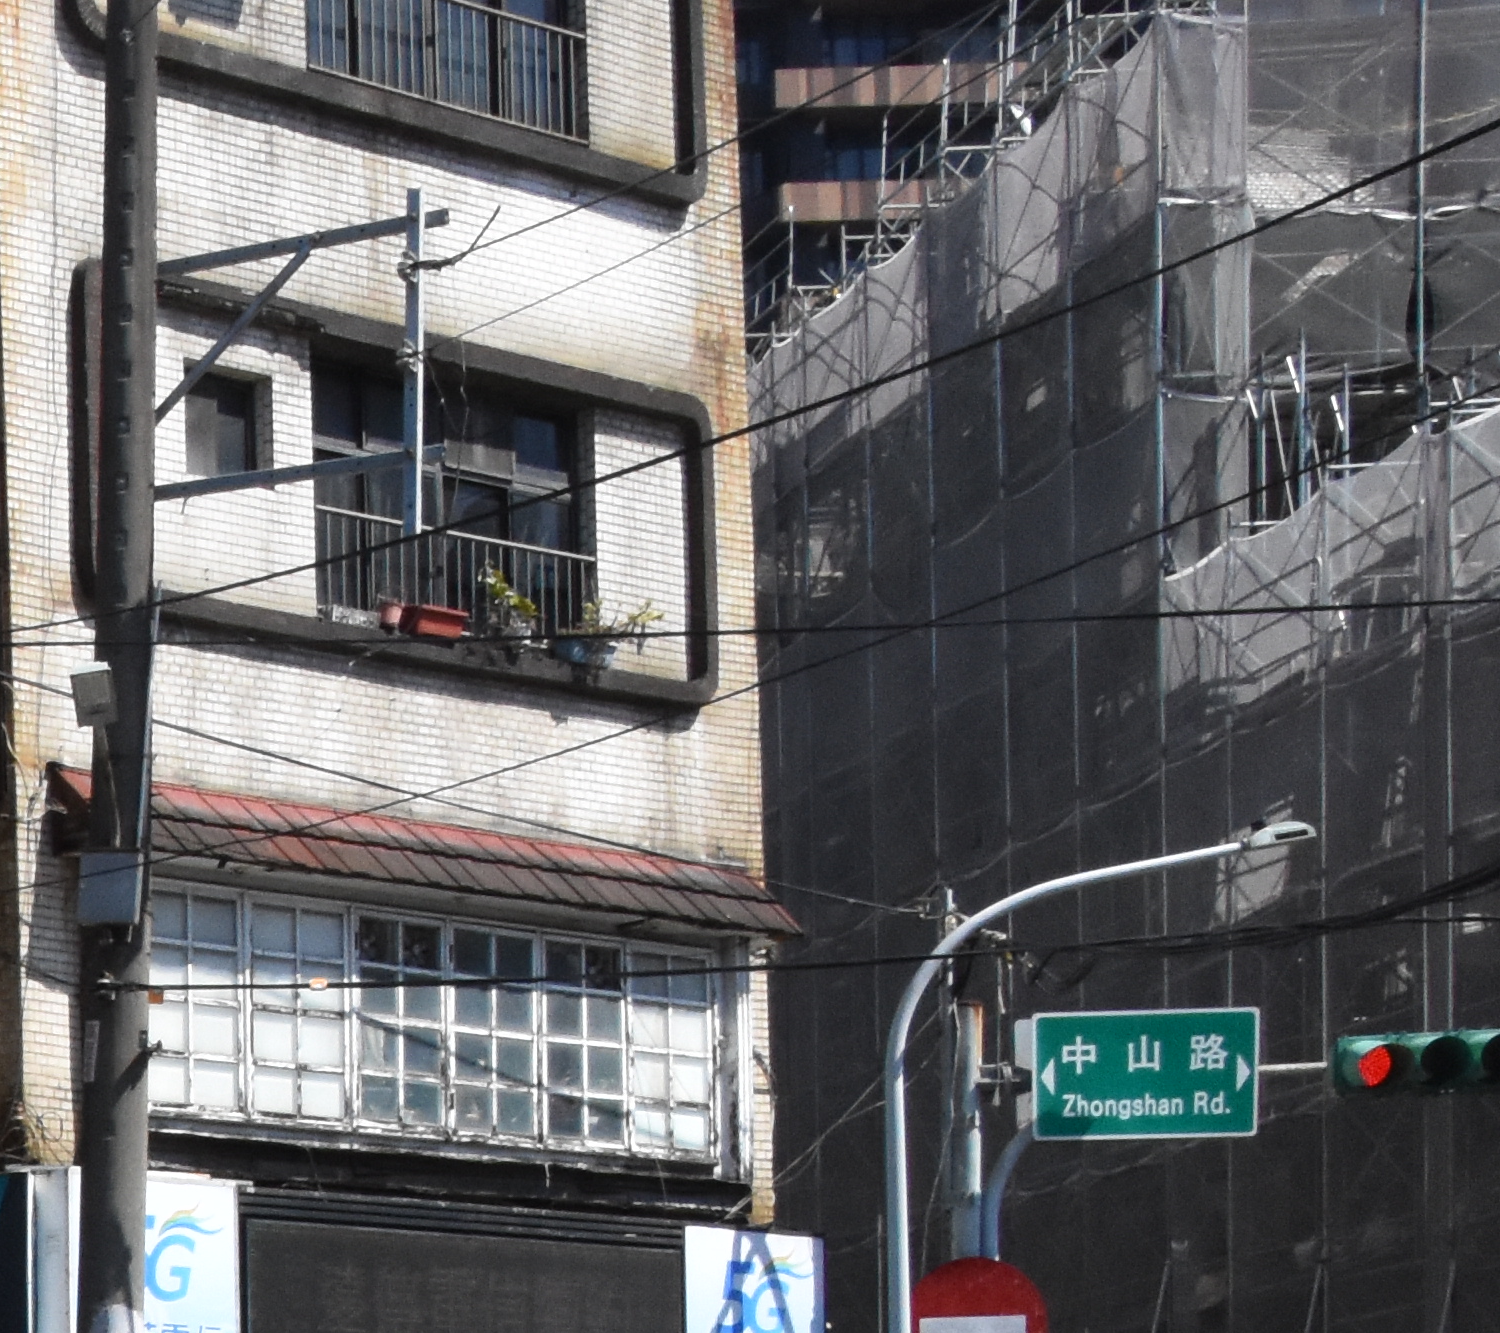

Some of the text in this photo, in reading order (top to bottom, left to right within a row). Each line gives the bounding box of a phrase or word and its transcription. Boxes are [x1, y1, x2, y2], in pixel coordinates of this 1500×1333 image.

[1062, 1034, 1228, 1074] 中山路
[1062, 1091, 1230, 1120] Zhongshan Rd.
[145, 1214, 197, 1302] G
